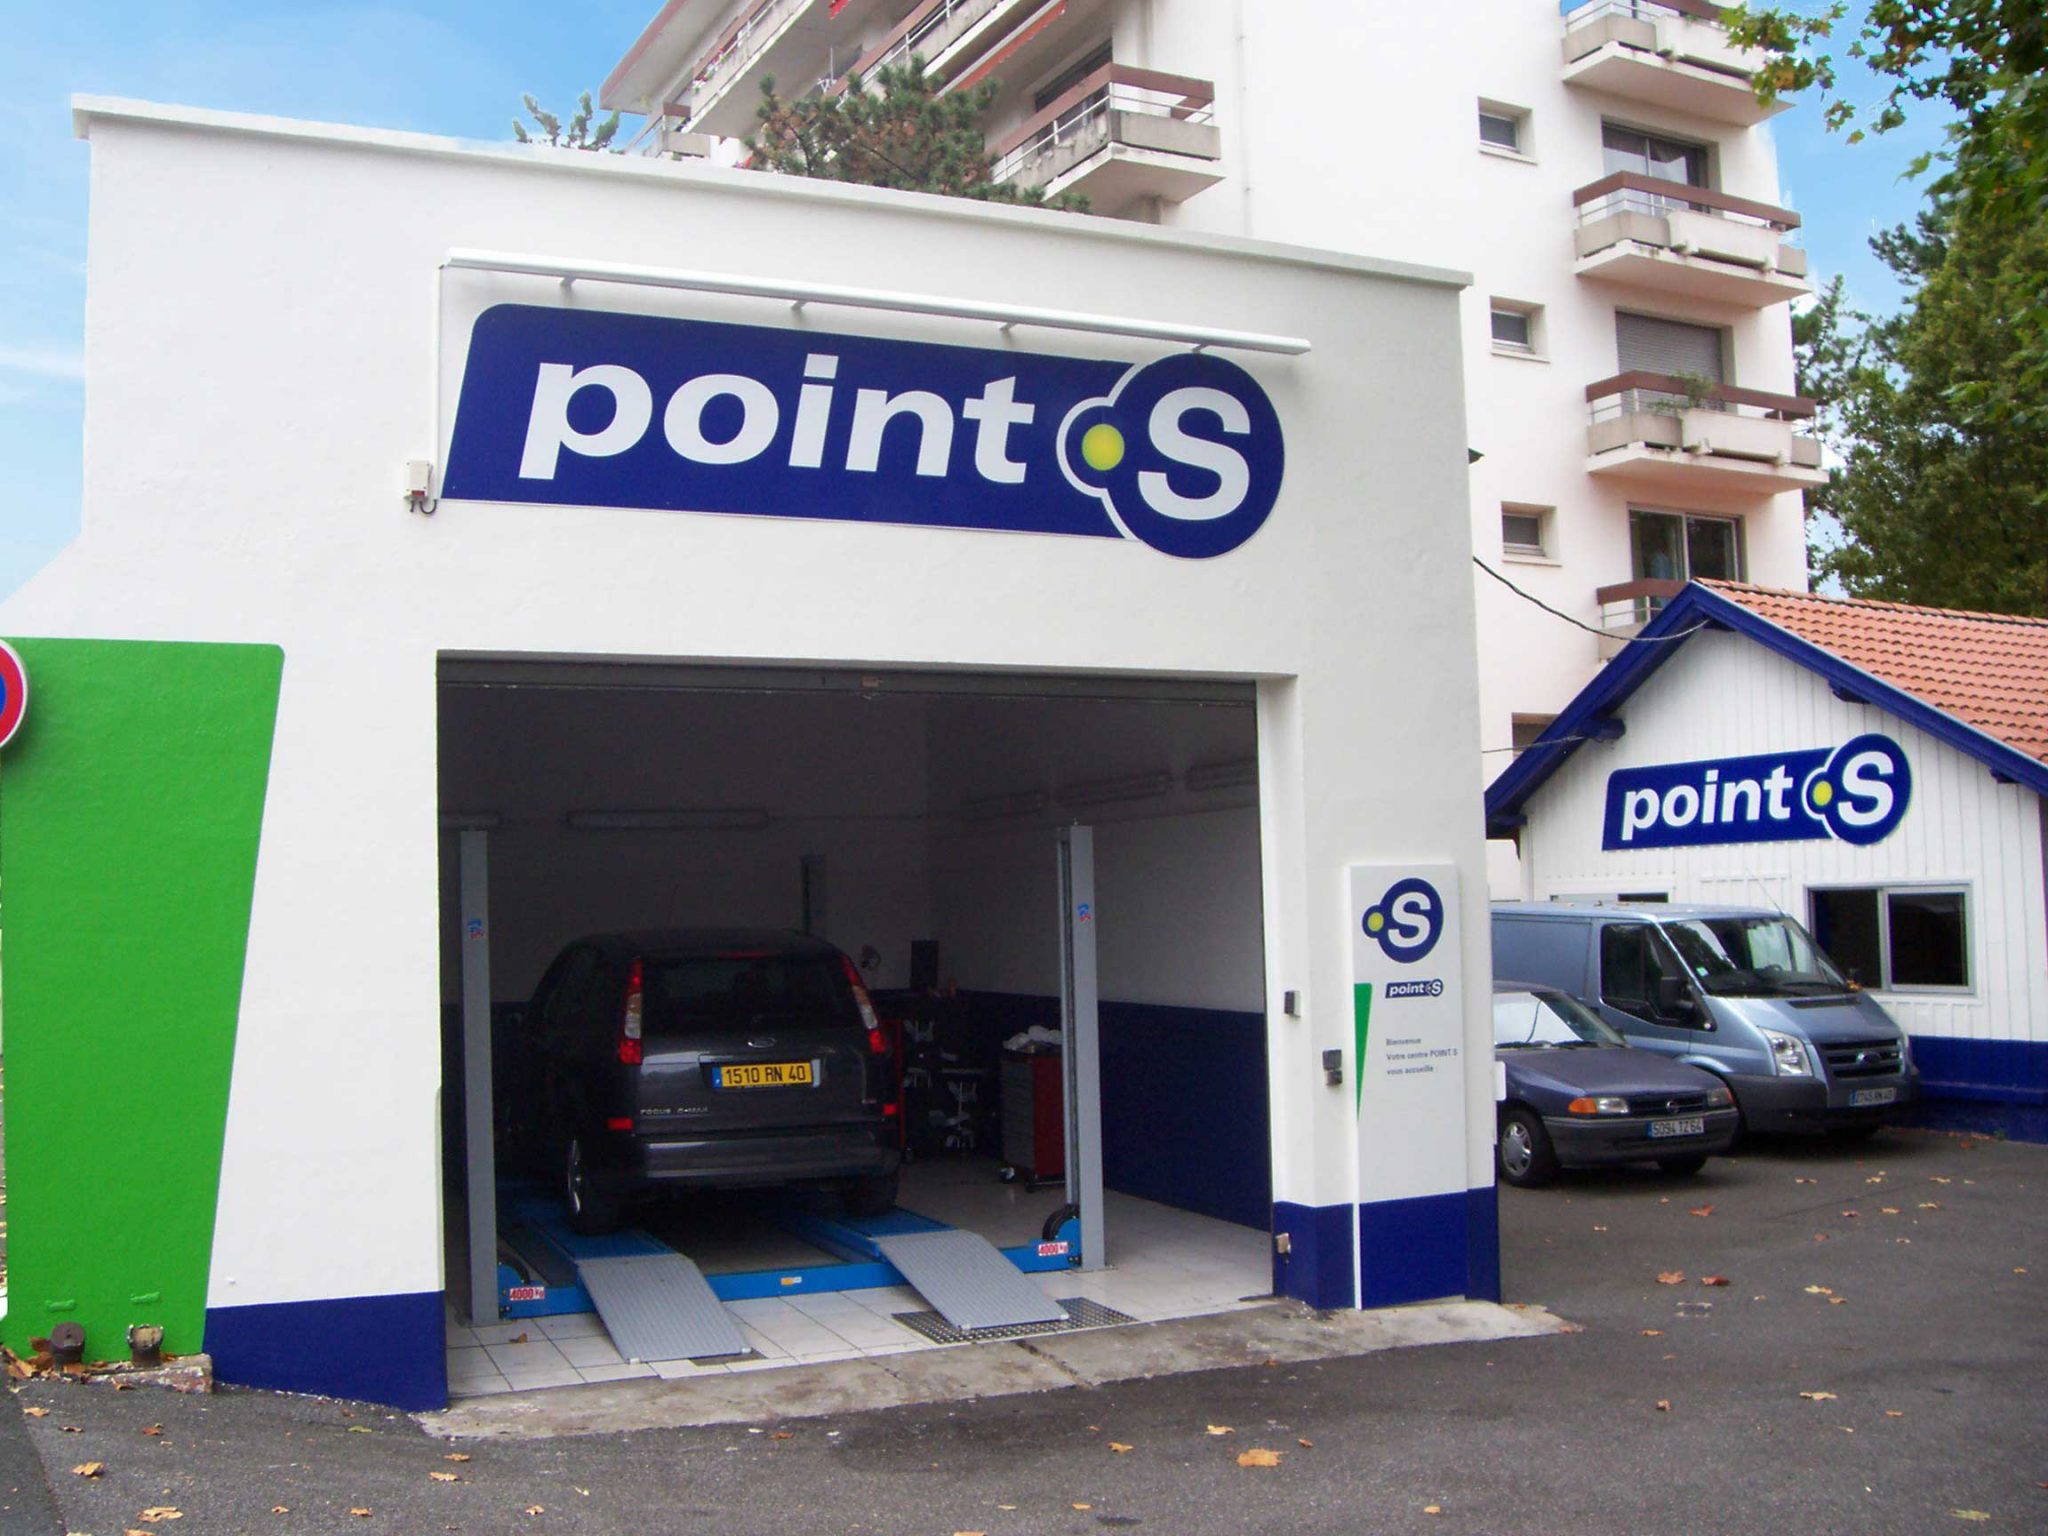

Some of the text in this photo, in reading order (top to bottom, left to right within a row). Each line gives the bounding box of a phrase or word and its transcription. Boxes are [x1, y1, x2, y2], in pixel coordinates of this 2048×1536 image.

[518, 353, 1251, 521] point S
[1621, 751, 1895, 841] point S
[1387, 891, 1432, 948] S
[1390, 981, 1442, 997] point S
[726, 1064, 806, 1084] 1510 RN 40
[511, 1287, 534, 1300] 4000
